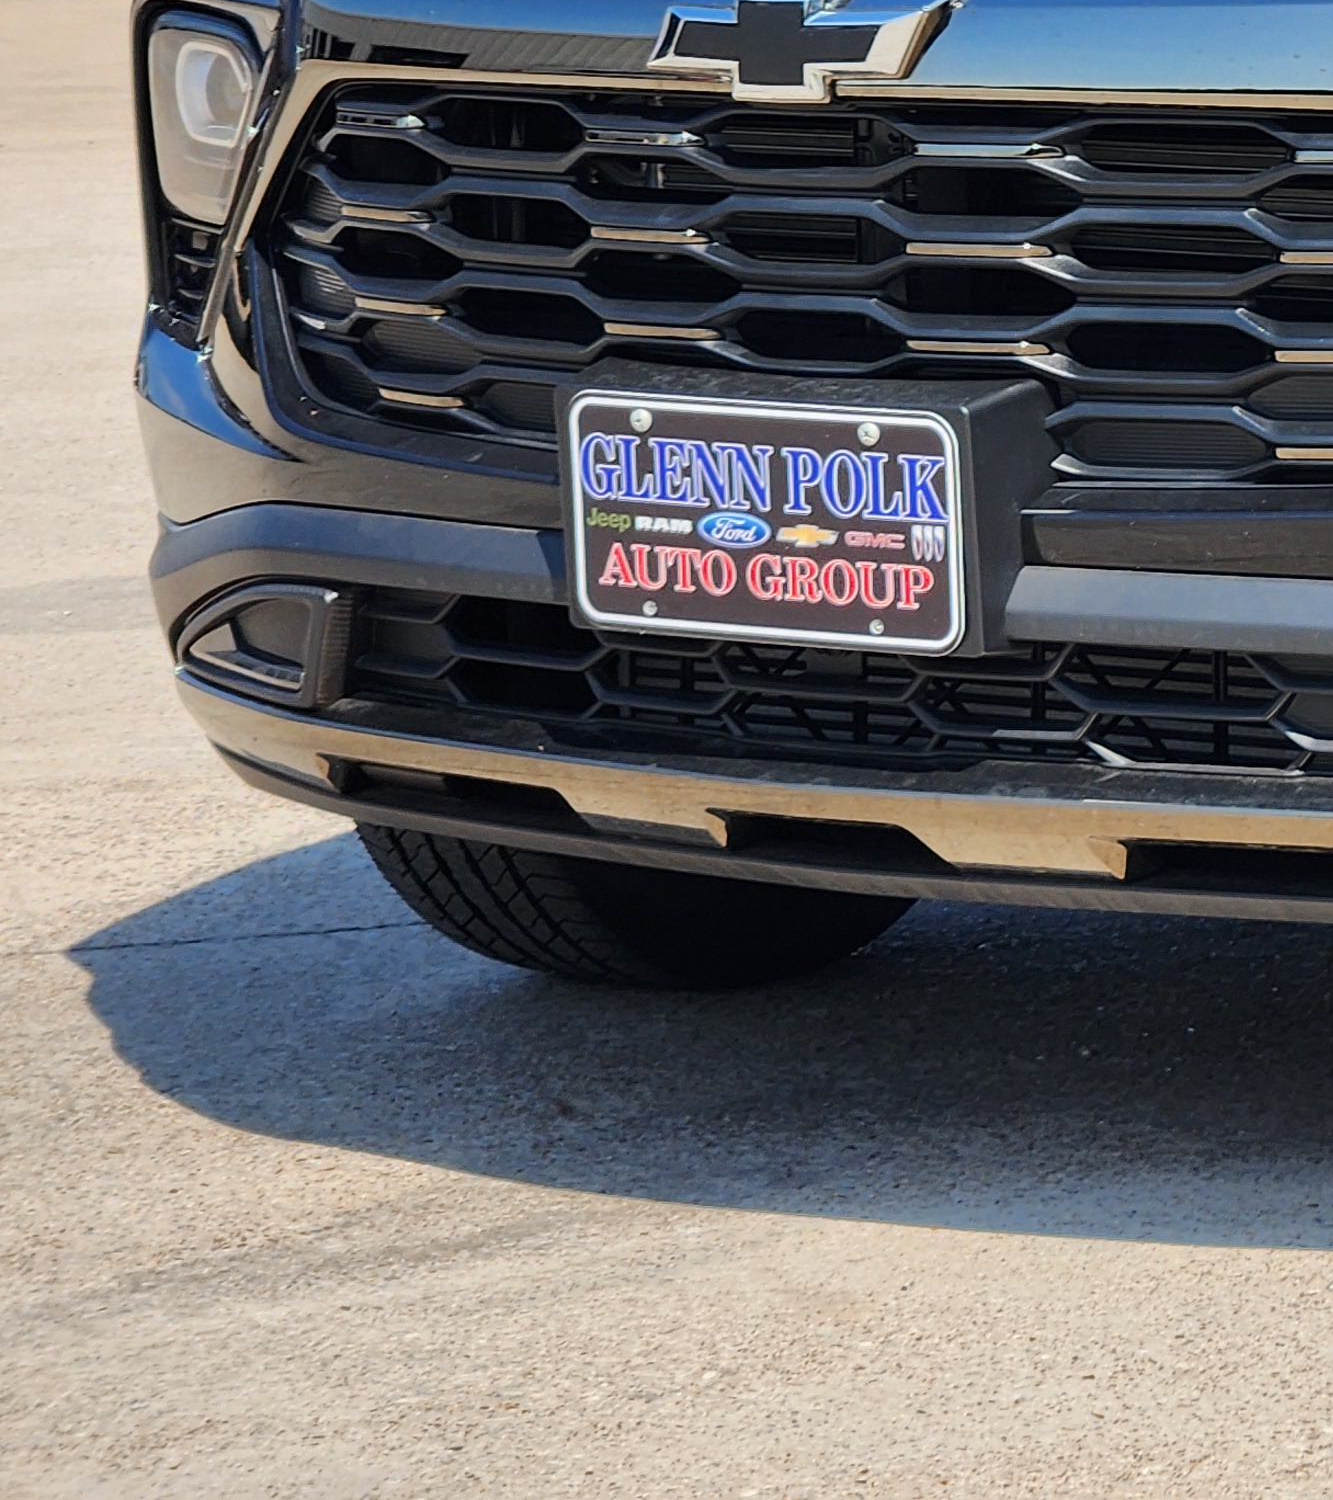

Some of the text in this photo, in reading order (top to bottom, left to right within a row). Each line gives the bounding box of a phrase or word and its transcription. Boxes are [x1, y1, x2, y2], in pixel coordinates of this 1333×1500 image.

[579, 432, 949, 523] GLENN POLK
[586, 507, 906, 550] Jeep RAM Ford GMC
[599, 542, 935, 610] AUTO GROUP
